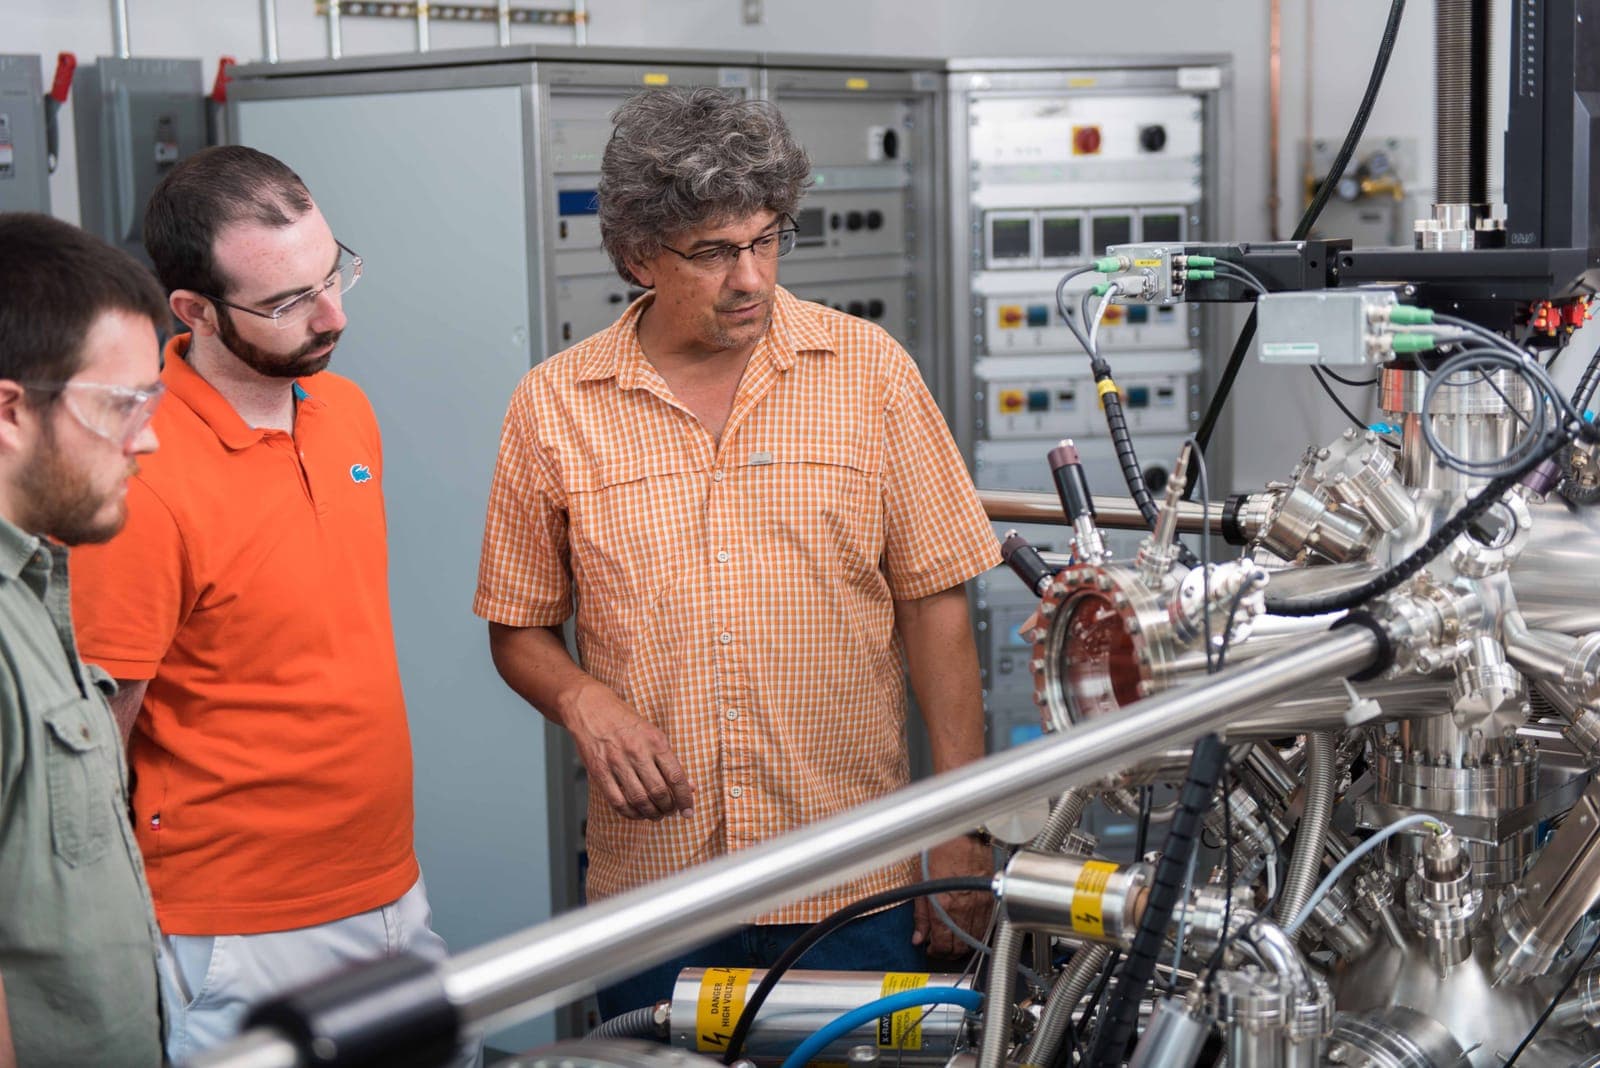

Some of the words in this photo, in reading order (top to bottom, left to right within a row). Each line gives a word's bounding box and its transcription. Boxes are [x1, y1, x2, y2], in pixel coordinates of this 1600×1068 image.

[710, 982, 723, 1015] DANGER
[722, 975, 737, 1004] VOLTAGE
[722, 1006, 731, 1027] HIGH
